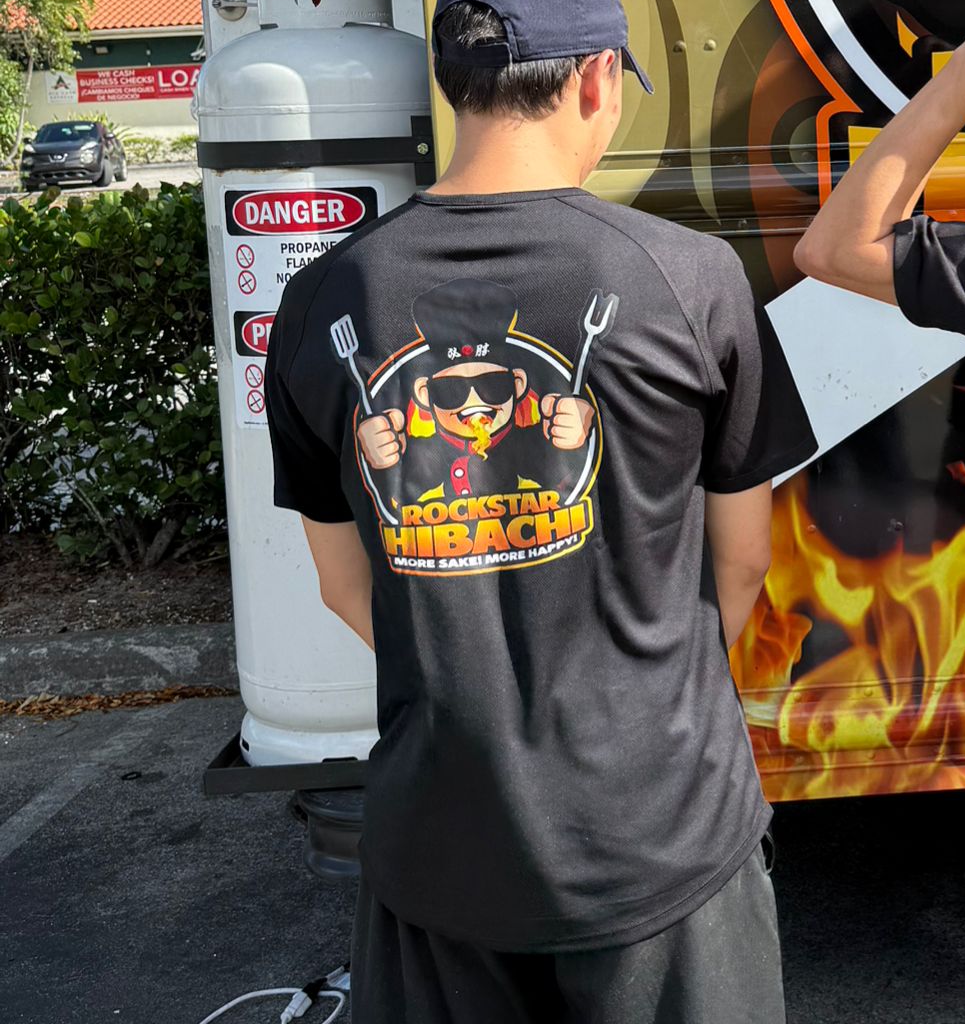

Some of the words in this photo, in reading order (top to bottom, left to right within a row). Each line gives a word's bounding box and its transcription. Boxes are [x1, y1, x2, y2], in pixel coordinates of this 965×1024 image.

[80, 77, 119, 87] BUSINESS
[120, 76, 155, 85] CHECKS!
[97, 70, 111, 78] WE
[112, 69, 135, 77] CASH
[123, 86, 155, 94] CHEQUES
[245, 198, 346, 225] DANGER
[402, 490, 561, 525] ROCKSTAR
[384, 503, 586, 557] HIBACHI
[394, 557, 435, 568] MORE
[438, 556, 482, 569] SAKE!
[485, 550, 526, 565] MORE
[528, 534, 579, 558] HAPPY!
